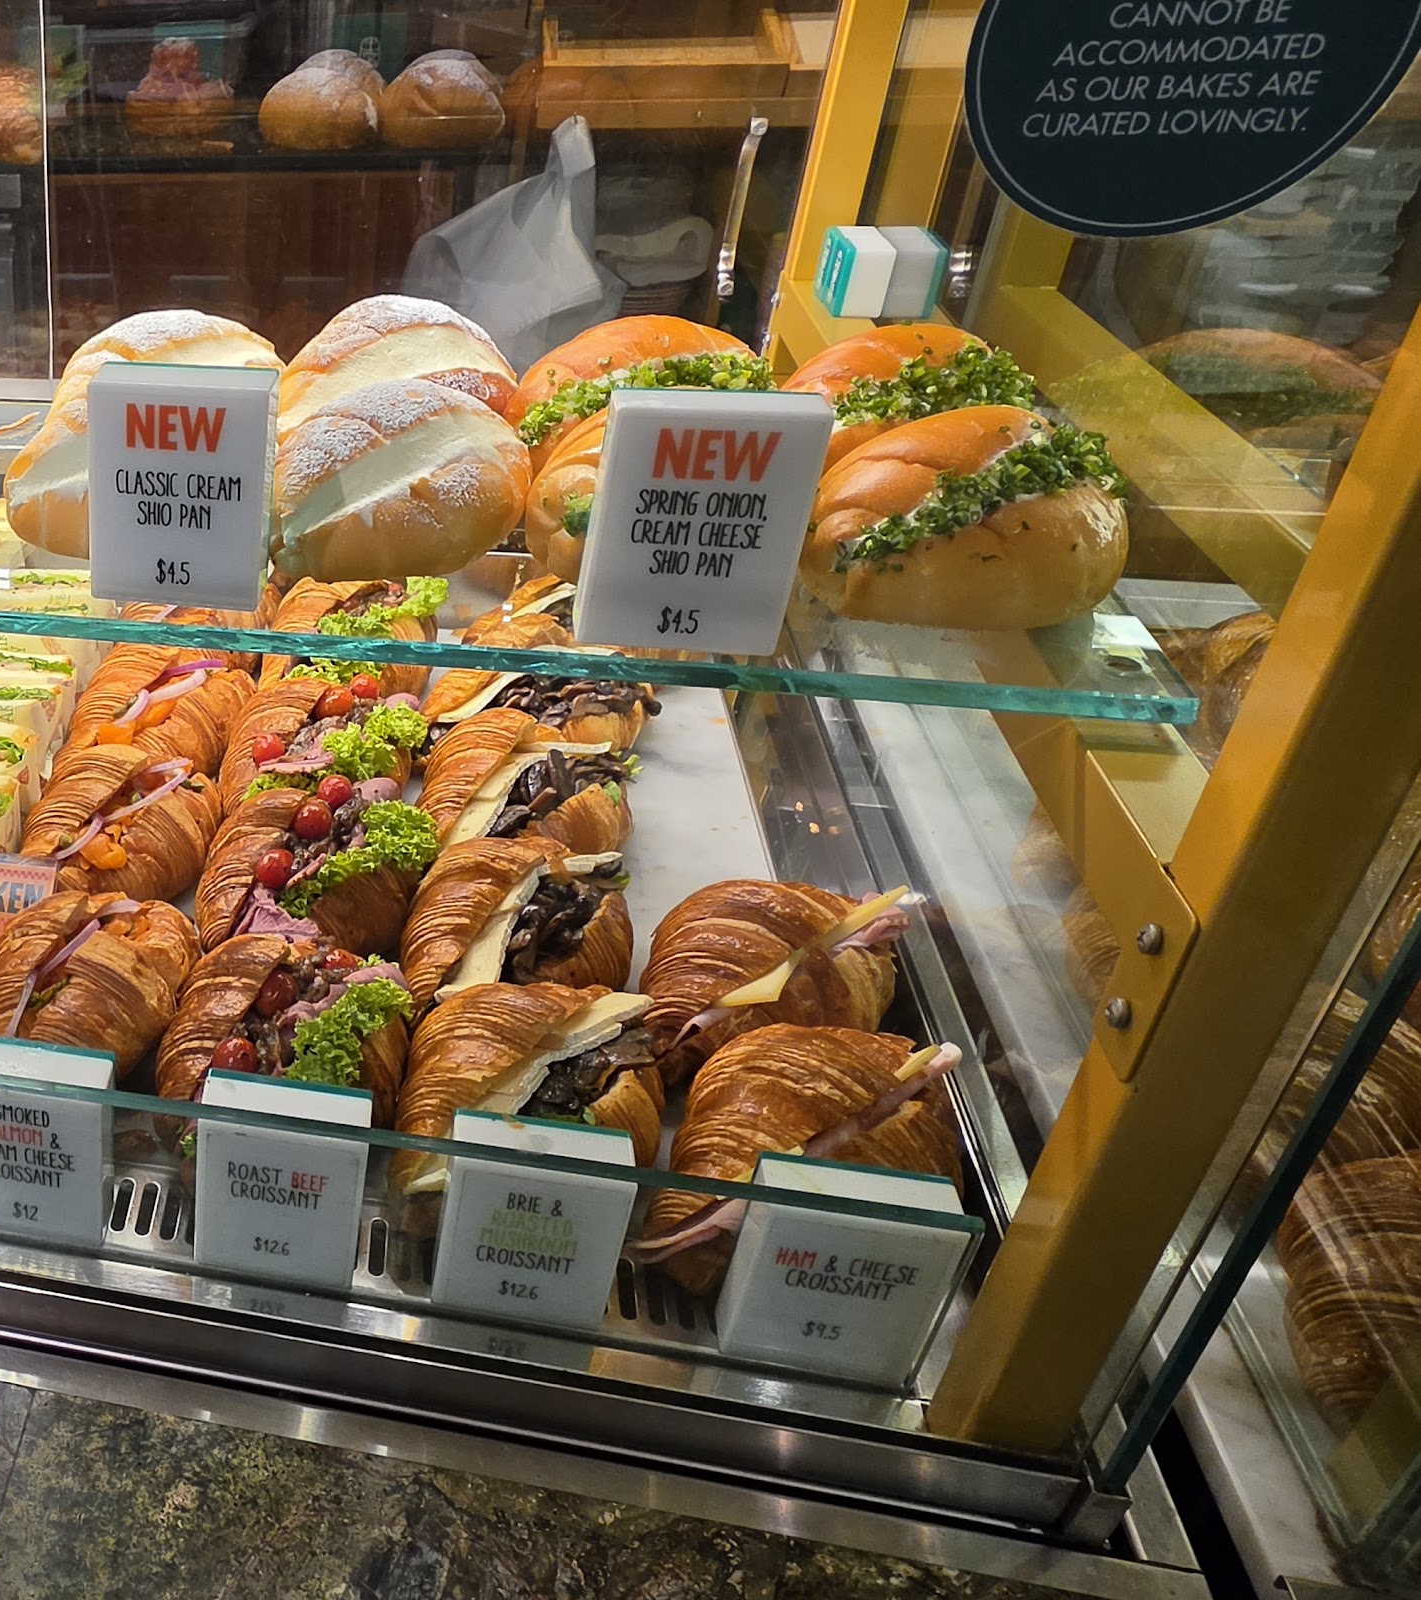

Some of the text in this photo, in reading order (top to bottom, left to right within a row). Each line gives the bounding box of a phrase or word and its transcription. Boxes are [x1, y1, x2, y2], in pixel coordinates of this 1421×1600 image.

[1109, 0, 1294, 28] CANNOT BE
[1052, 33, 1326, 67] ACCOMMODATED
[1035, 70, 1323, 103] AS OUR BAKES ARE
[1022, 106, 1310, 138] CURATED LOVINGLY.
[126, 403, 227, 453] NEW
[652, 428, 783, 482] NEW
[115, 469, 241, 502] CLASSIC CREAM
[137, 501, 211, 530] SHIO PAN
[635, 489, 767, 522] SPRING ONION,
[631, 519, 765, 549] CREAM CHEESE
[155, 558, 190, 585] $4.5
[649, 549, 734, 578] SHIO PAN
[657, 606, 700, 634] $4.5
[50, 1133, 61, 1150] &
[24, 1147, 76, 1172] CHEESE
[227, 1161, 330, 1193] ROAST BEEF
[230, 1180, 322, 1210] CROISSANT
[506, 1191, 563, 1217] BRIE &
[12, 1201, 39, 1221] $12
[476, 1245, 576, 1274] CROISSANT
[775, 1248, 920, 1286] HAM & CHEESE
[785, 1268, 896, 1301] CROISSANT
[802, 1320, 842, 1340] $9.5
